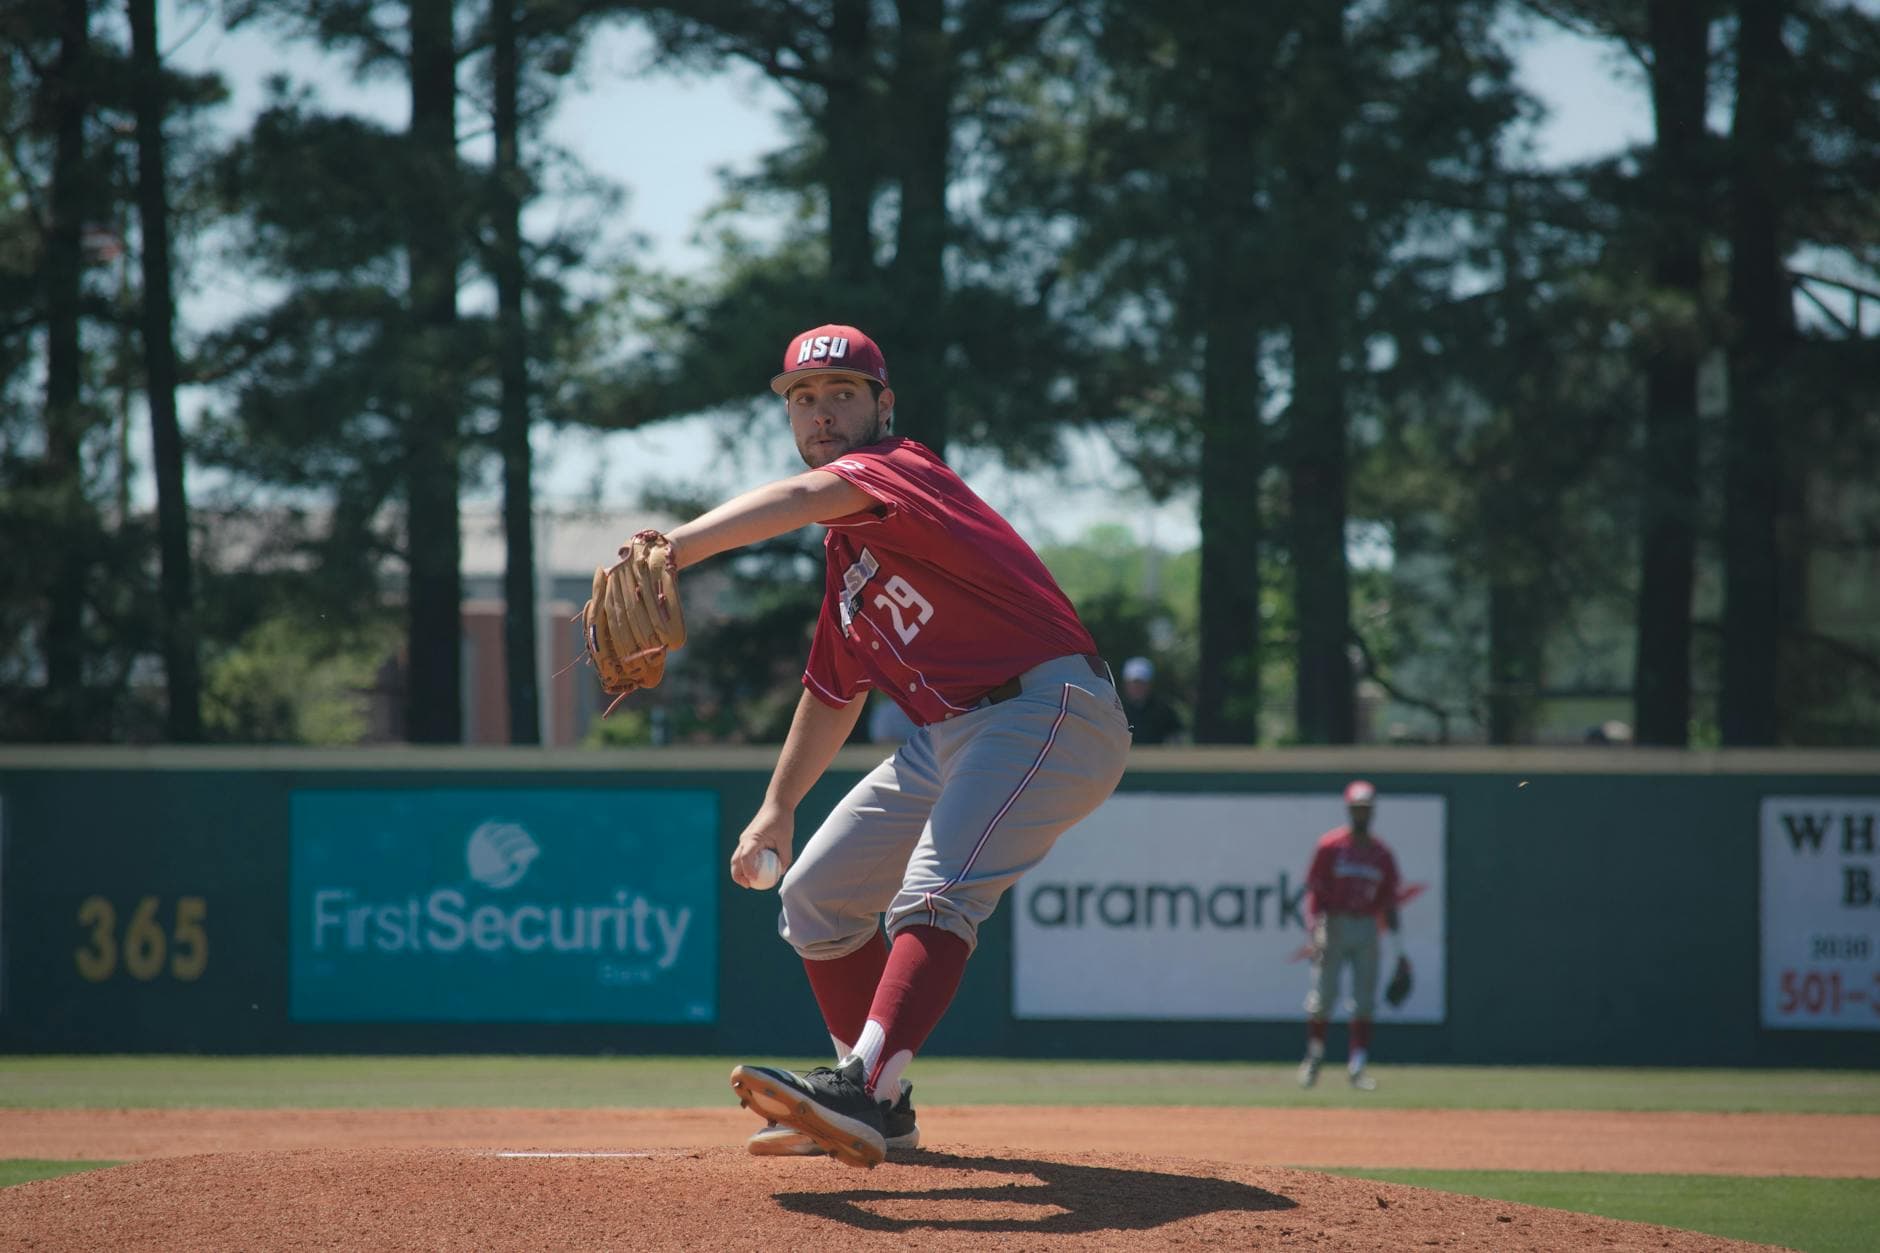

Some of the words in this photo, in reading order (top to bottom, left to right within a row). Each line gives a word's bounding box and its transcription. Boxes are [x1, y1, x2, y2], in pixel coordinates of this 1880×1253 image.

[797, 336, 848, 365] HSU
[874, 575, 934, 645] 29
[1028, 871, 1310, 929] aramark
[1842, 863, 1880, 907] B
[76, 897, 209, 980] 365
